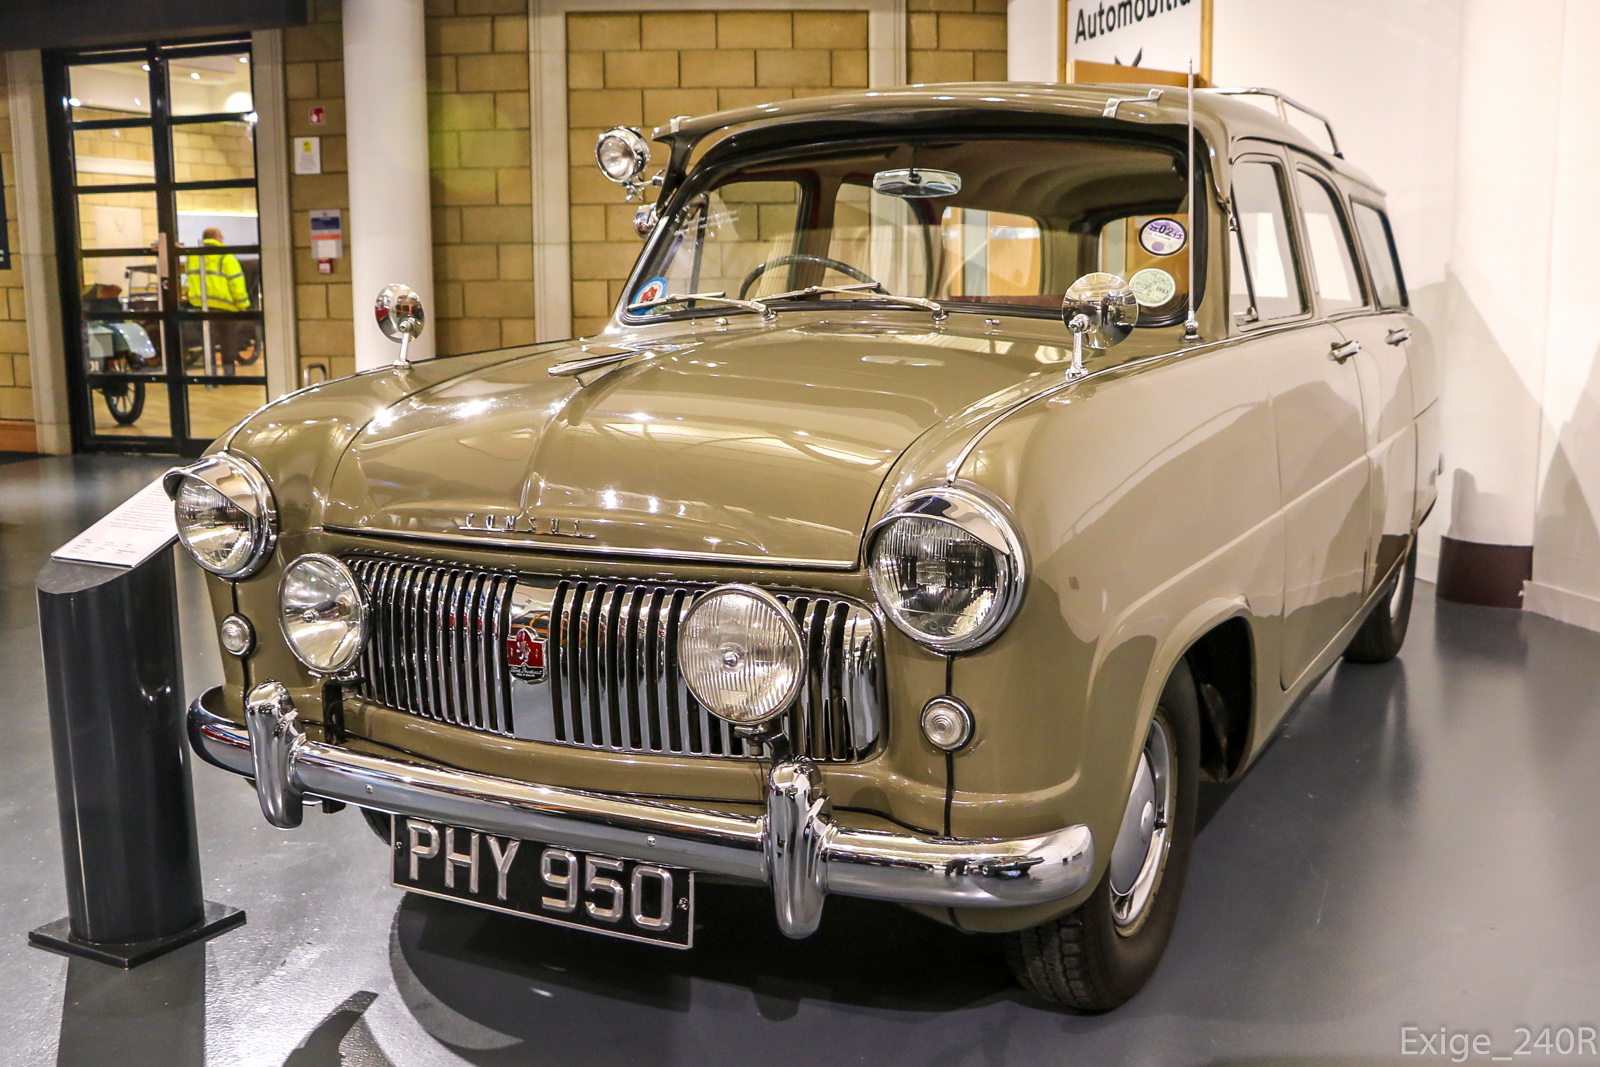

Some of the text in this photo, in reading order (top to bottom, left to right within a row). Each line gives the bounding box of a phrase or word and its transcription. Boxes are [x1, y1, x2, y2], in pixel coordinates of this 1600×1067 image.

[1075, 0, 1191, 44] Automob
[1159, 225, 1174, 236] 02
[406, 819, 674, 931] PHY 950
